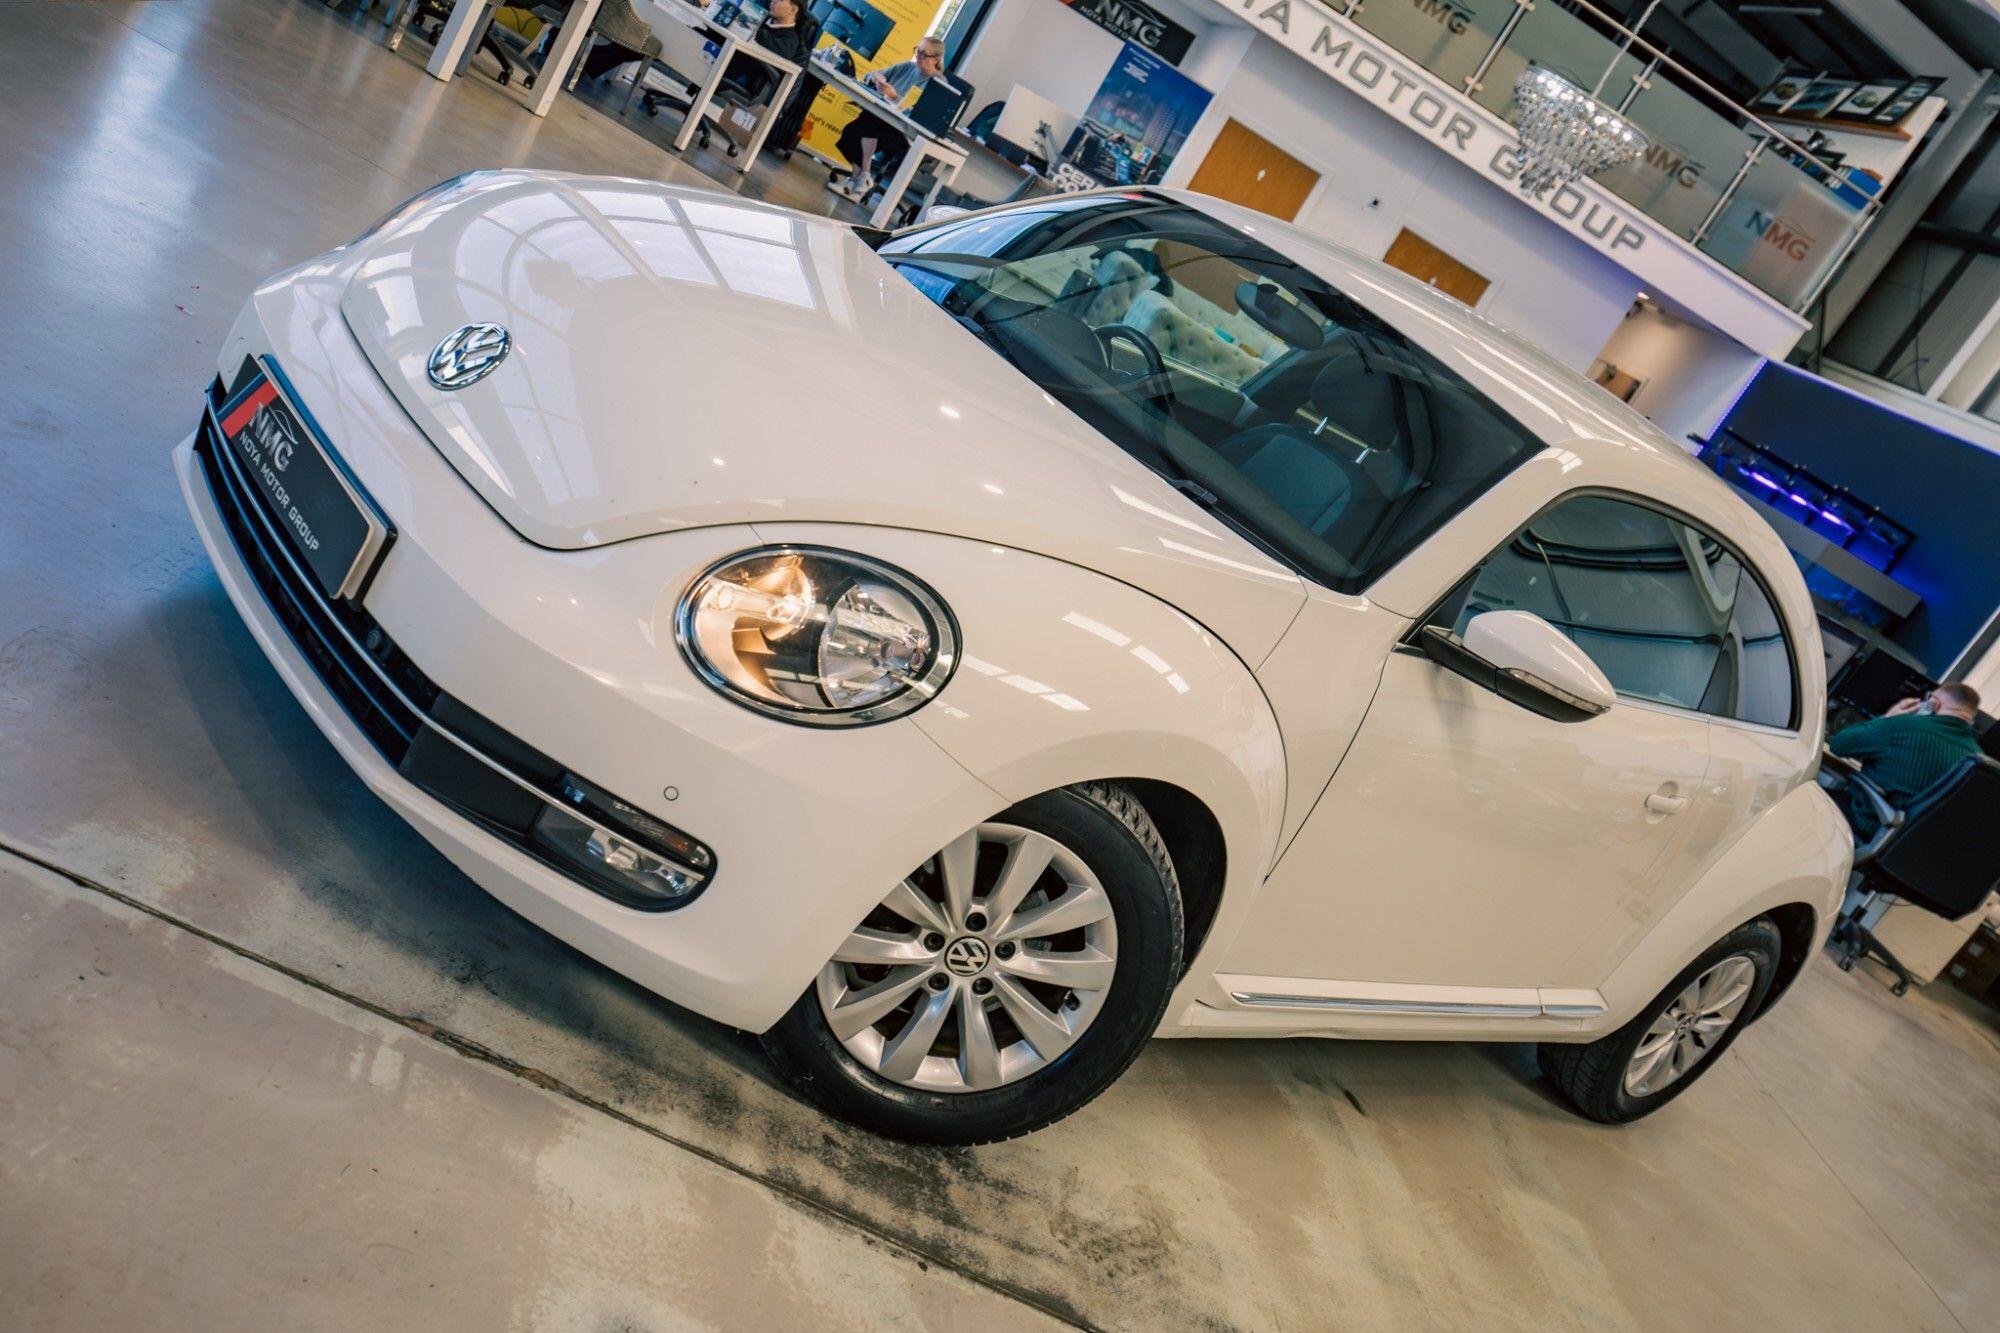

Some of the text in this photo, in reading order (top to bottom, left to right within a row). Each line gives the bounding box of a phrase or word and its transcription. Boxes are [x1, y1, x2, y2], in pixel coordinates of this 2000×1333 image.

[1095, 0, 1164, 48] NMG
[1104, 21, 1131, 41] MOTO
[1311, 26, 1478, 151] MOTOR
[1489, 144, 1646, 250] GOUP
[1744, 210, 1810, 261] NMG
[249, 402, 294, 472] NMG
[239, 430, 320, 551] NOYA MOTOR GROUP
